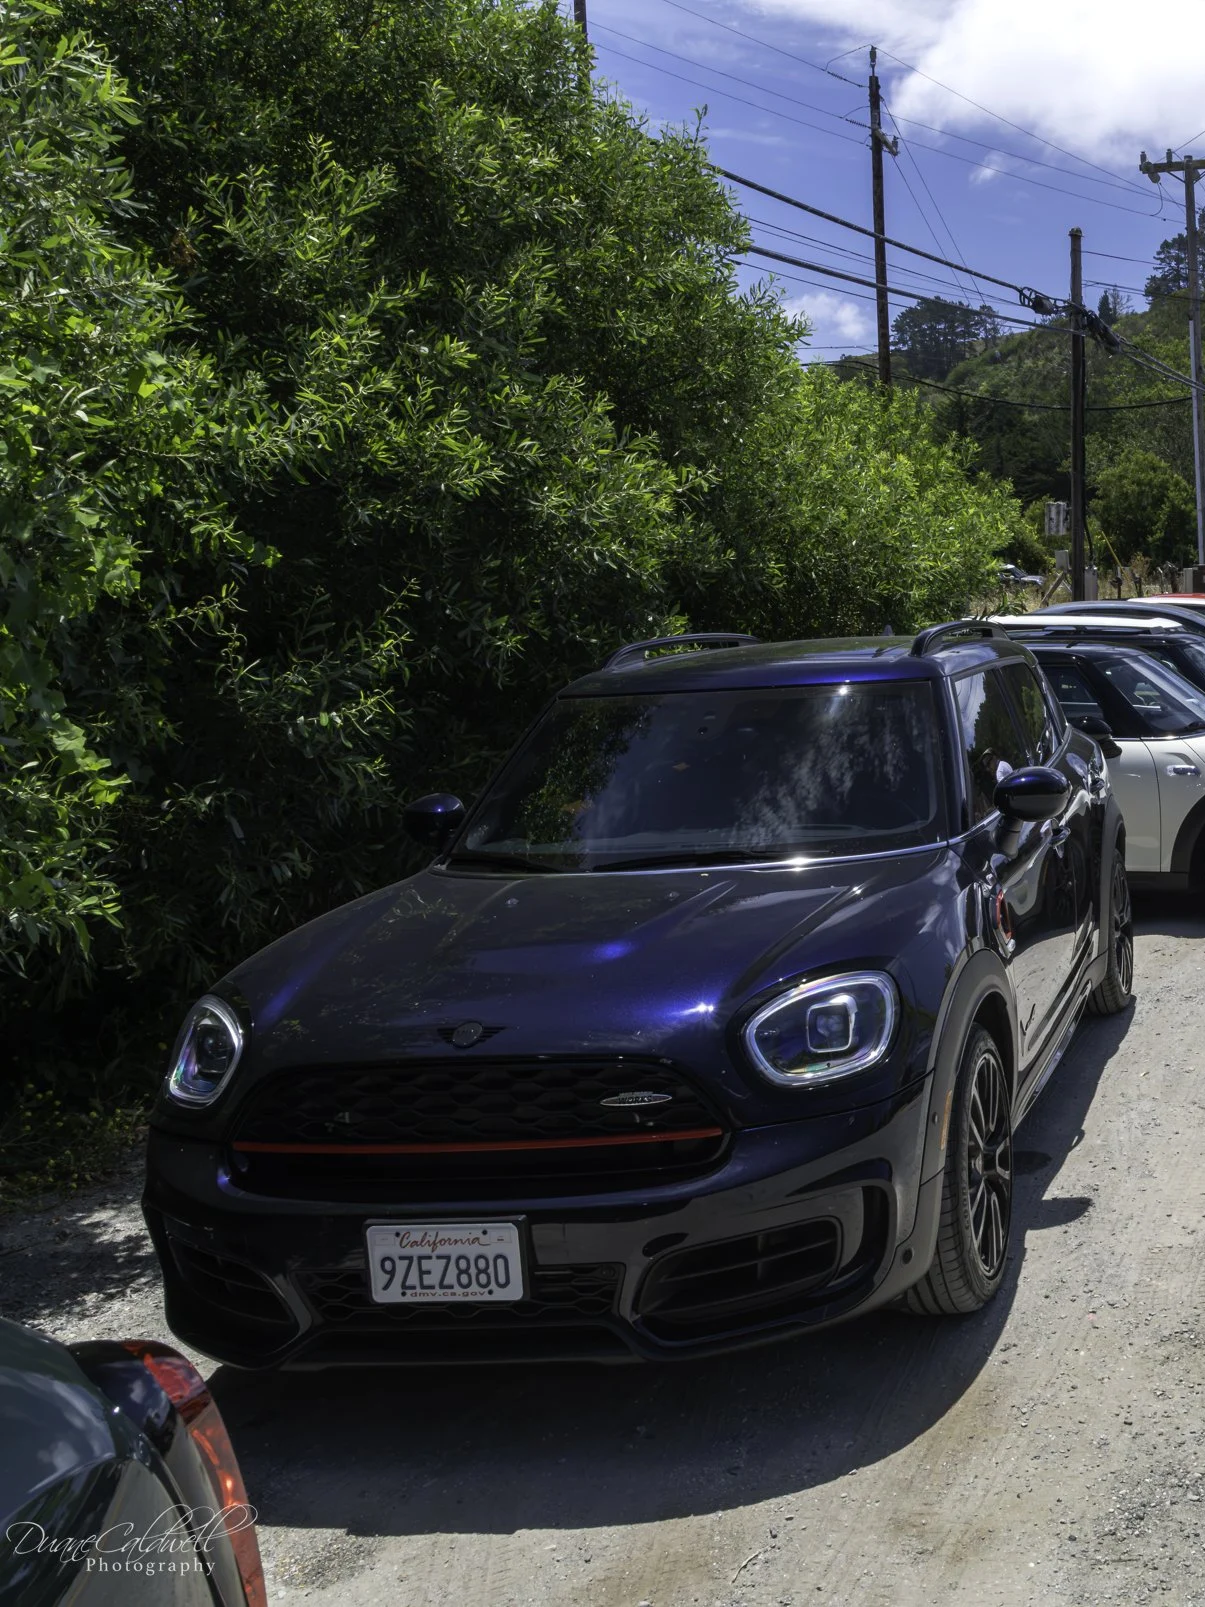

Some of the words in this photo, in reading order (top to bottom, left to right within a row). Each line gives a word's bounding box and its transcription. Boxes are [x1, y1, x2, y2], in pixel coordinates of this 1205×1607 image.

[399, 1231, 490, 1253] California
[380, 1254, 511, 1291] 9ZEZ880
[410, 1290, 486, 1298] dmv.ca.gov
